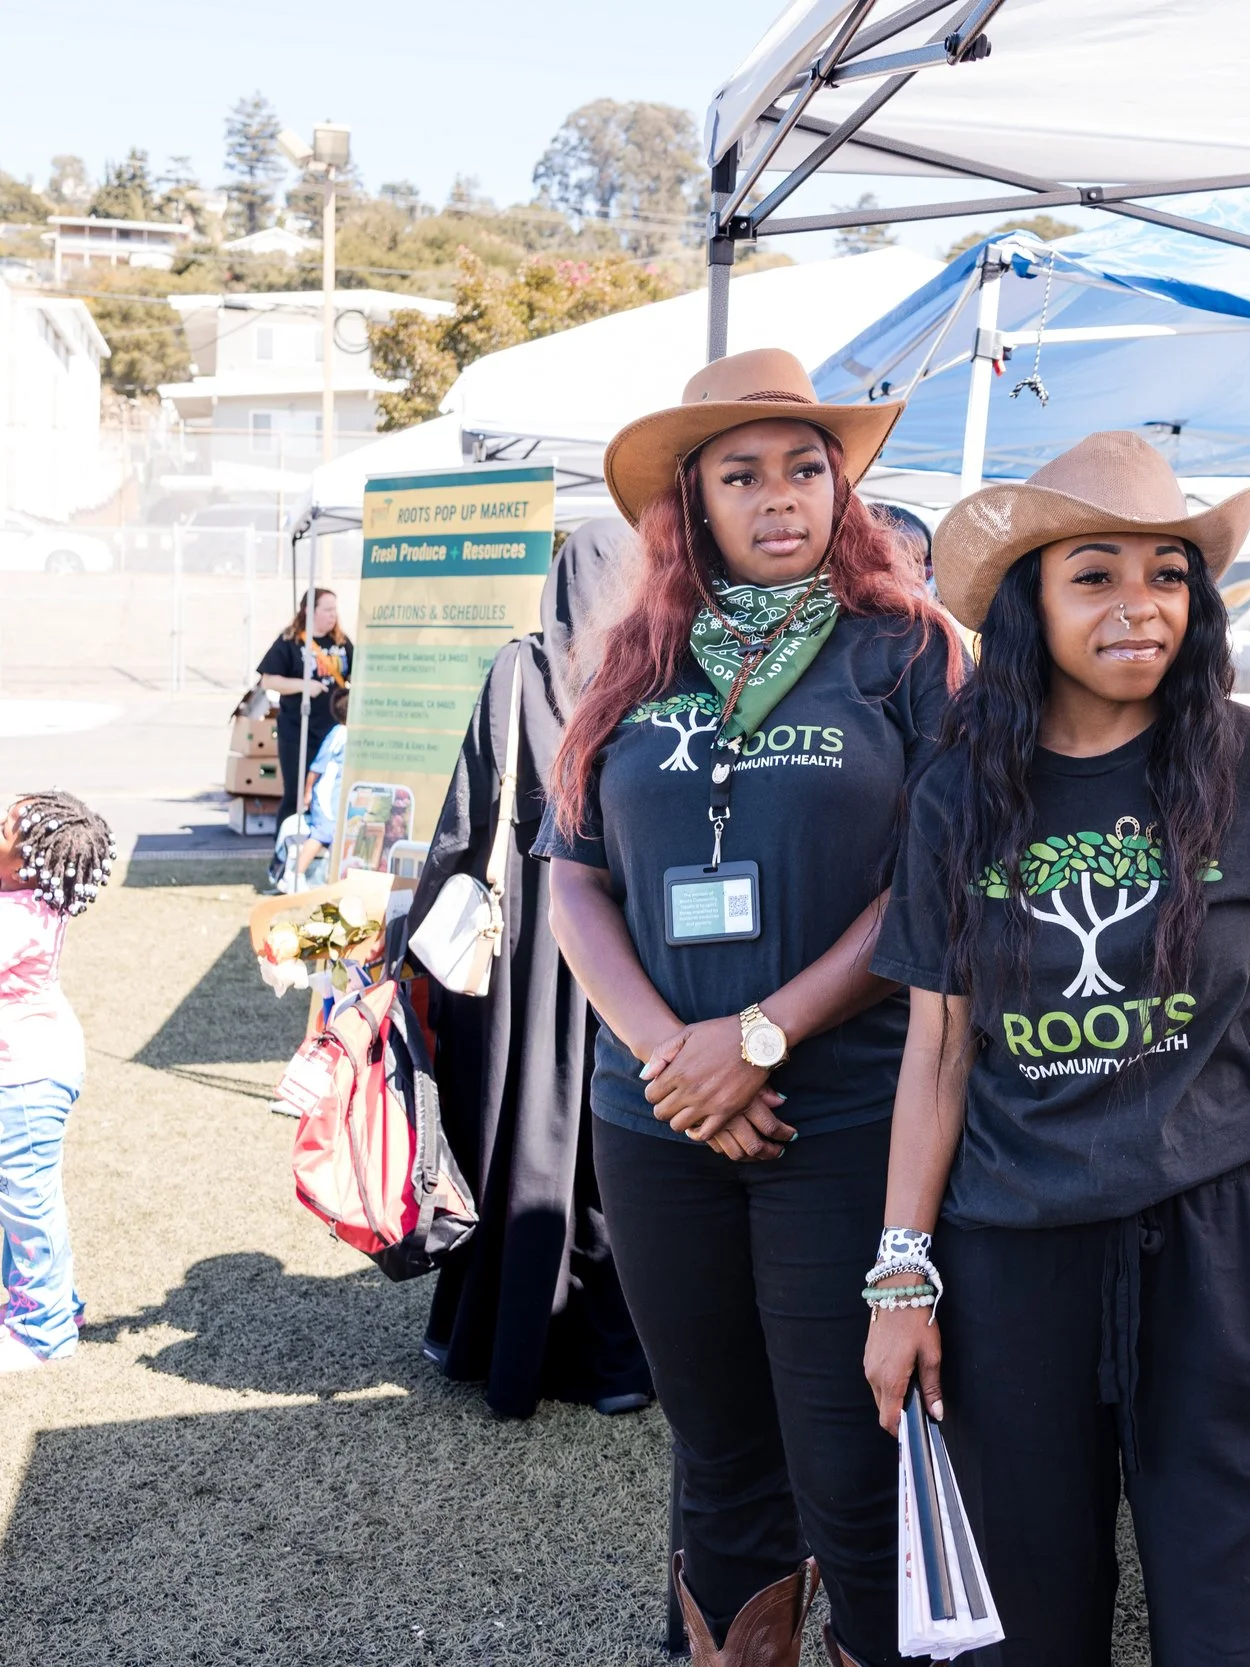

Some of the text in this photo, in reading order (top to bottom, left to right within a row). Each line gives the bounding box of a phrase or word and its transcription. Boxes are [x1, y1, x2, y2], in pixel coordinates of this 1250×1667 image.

[397, 504, 431, 525] ROOTS
[434, 504, 457, 522] POP
[461, 503, 477, 521] UP
[480, 501, 529, 519] MARKET
[371, 544, 398, 563] Fresh
[399, 542, 447, 562] Produce
[462, 540, 527, 560] Resources
[372, 604, 506, 620] LOCATIONS & SCHEDULES
[741, 725, 844, 757] OOTS
[731, 754, 843, 773] MMUNITY HEALTH
[1003, 993, 1197, 1057] ROOTS
[1019, 1057, 1126, 1080] COMMUNITY
